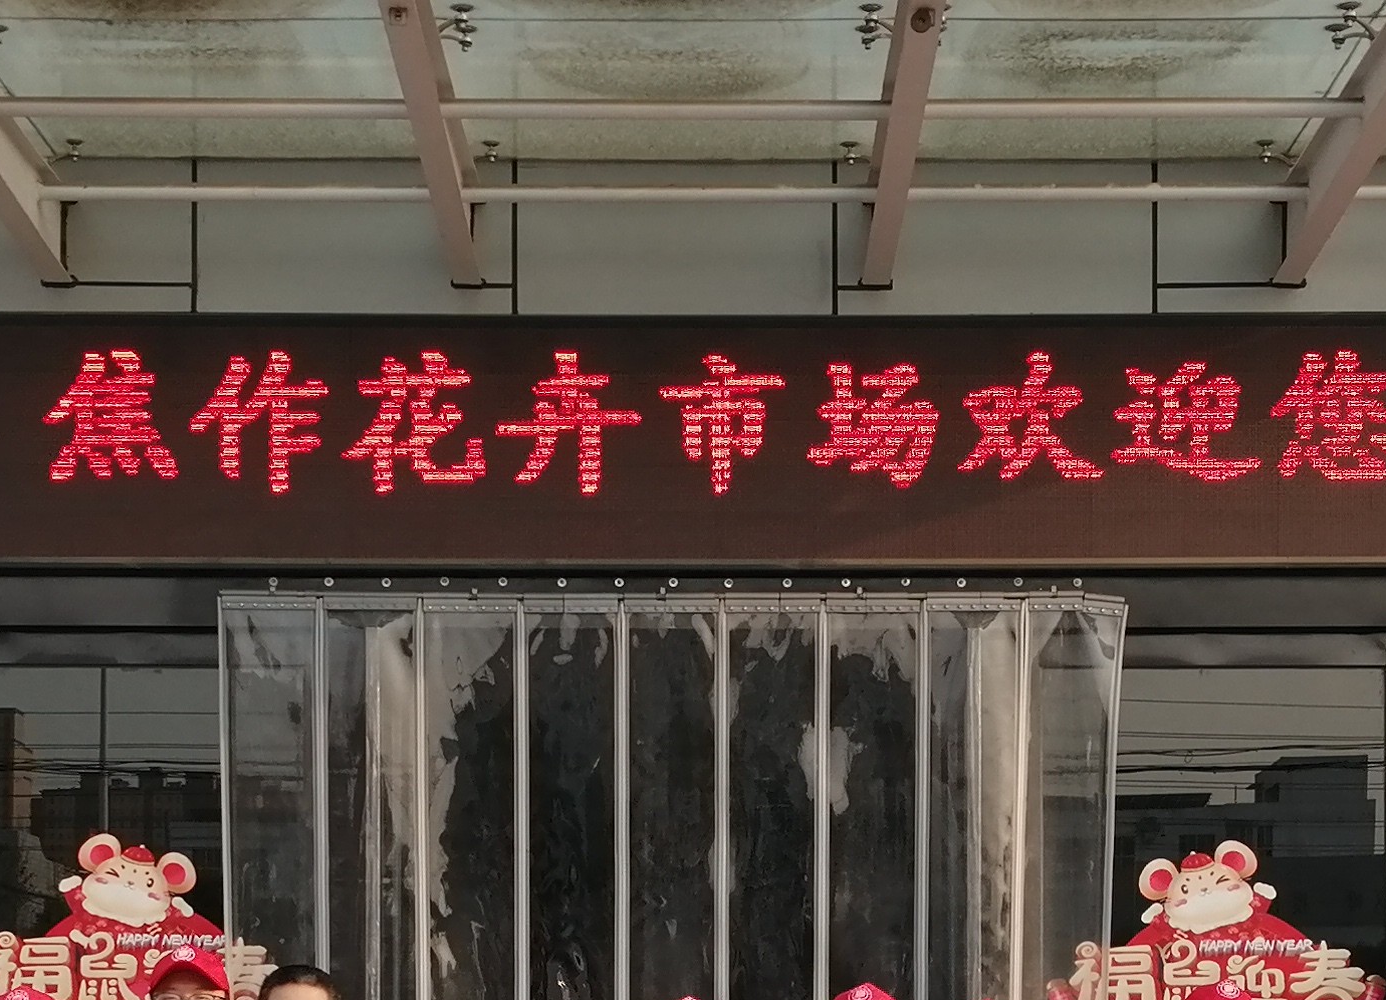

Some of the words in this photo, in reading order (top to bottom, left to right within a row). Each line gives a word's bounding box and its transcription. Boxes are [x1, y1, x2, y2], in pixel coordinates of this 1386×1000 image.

[117, 933, 159, 945] HAPPY
[162, 934, 193, 946] NEW
[1199, 940, 1242, 954] HAPPY
[1244, 940, 1277, 954] NEW
[1277, 940, 1313, 952] YEAR
